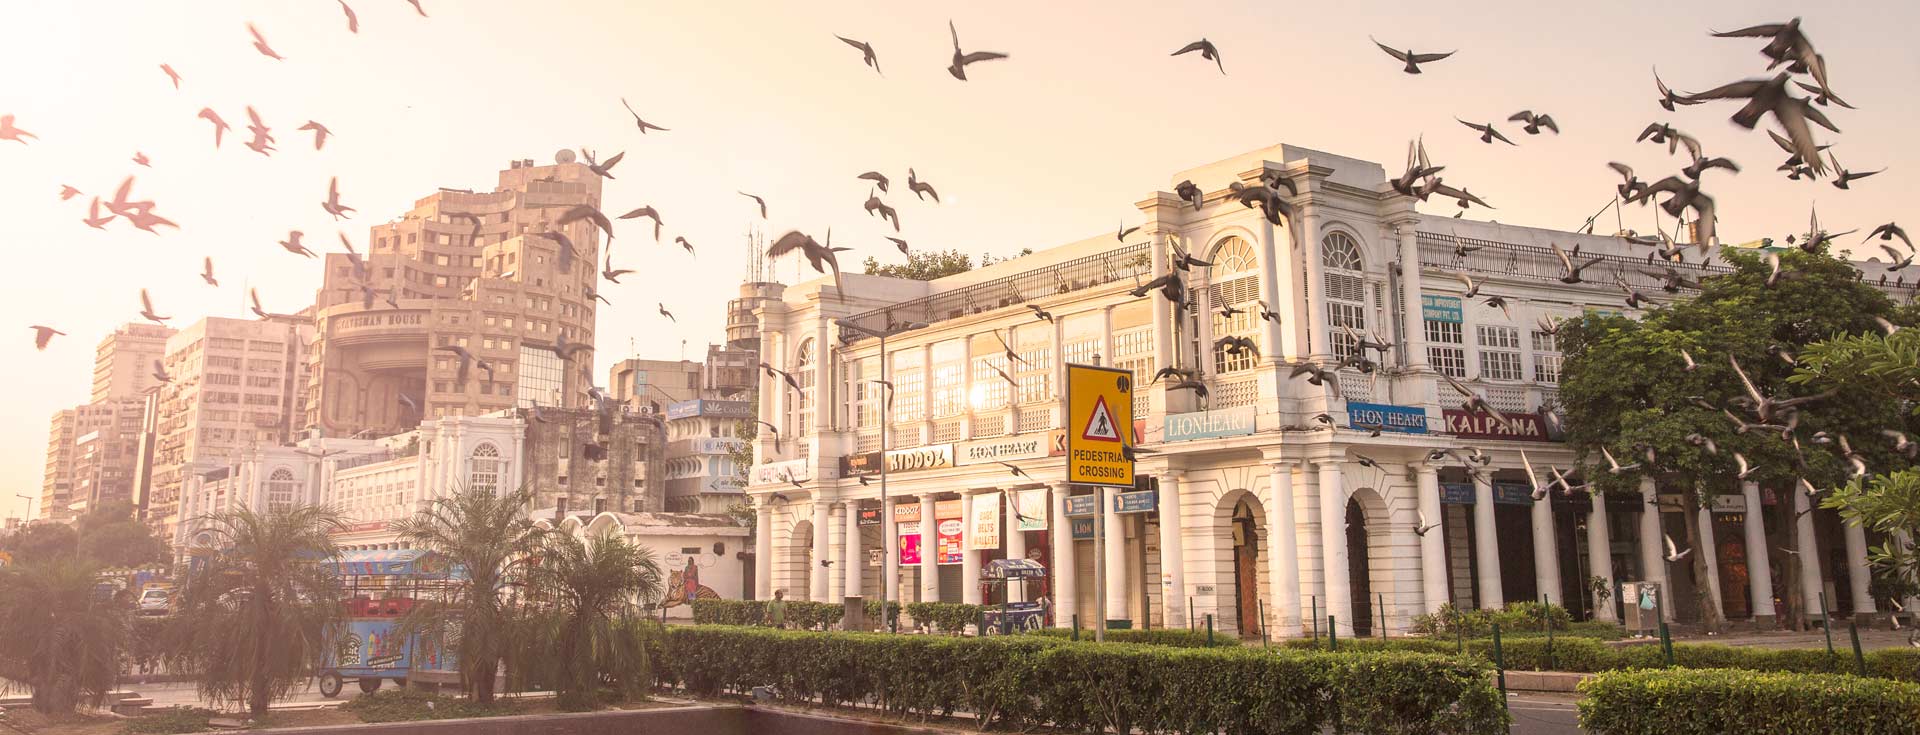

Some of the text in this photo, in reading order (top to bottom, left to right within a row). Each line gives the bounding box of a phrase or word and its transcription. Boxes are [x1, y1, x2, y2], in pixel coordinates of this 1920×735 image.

[388, 314, 423, 326] HOUSE
[1169, 412, 1247, 437] LIONHEART
[1354, 409, 1425, 427] LION HEART
[1446, 414, 1539, 437] KALPANA
[970, 444, 998, 460] LION
[1000, 440, 1038, 456] HEART
[1079, 465, 1125, 479] CROSSING
[977, 523, 994, 533] BELTS
